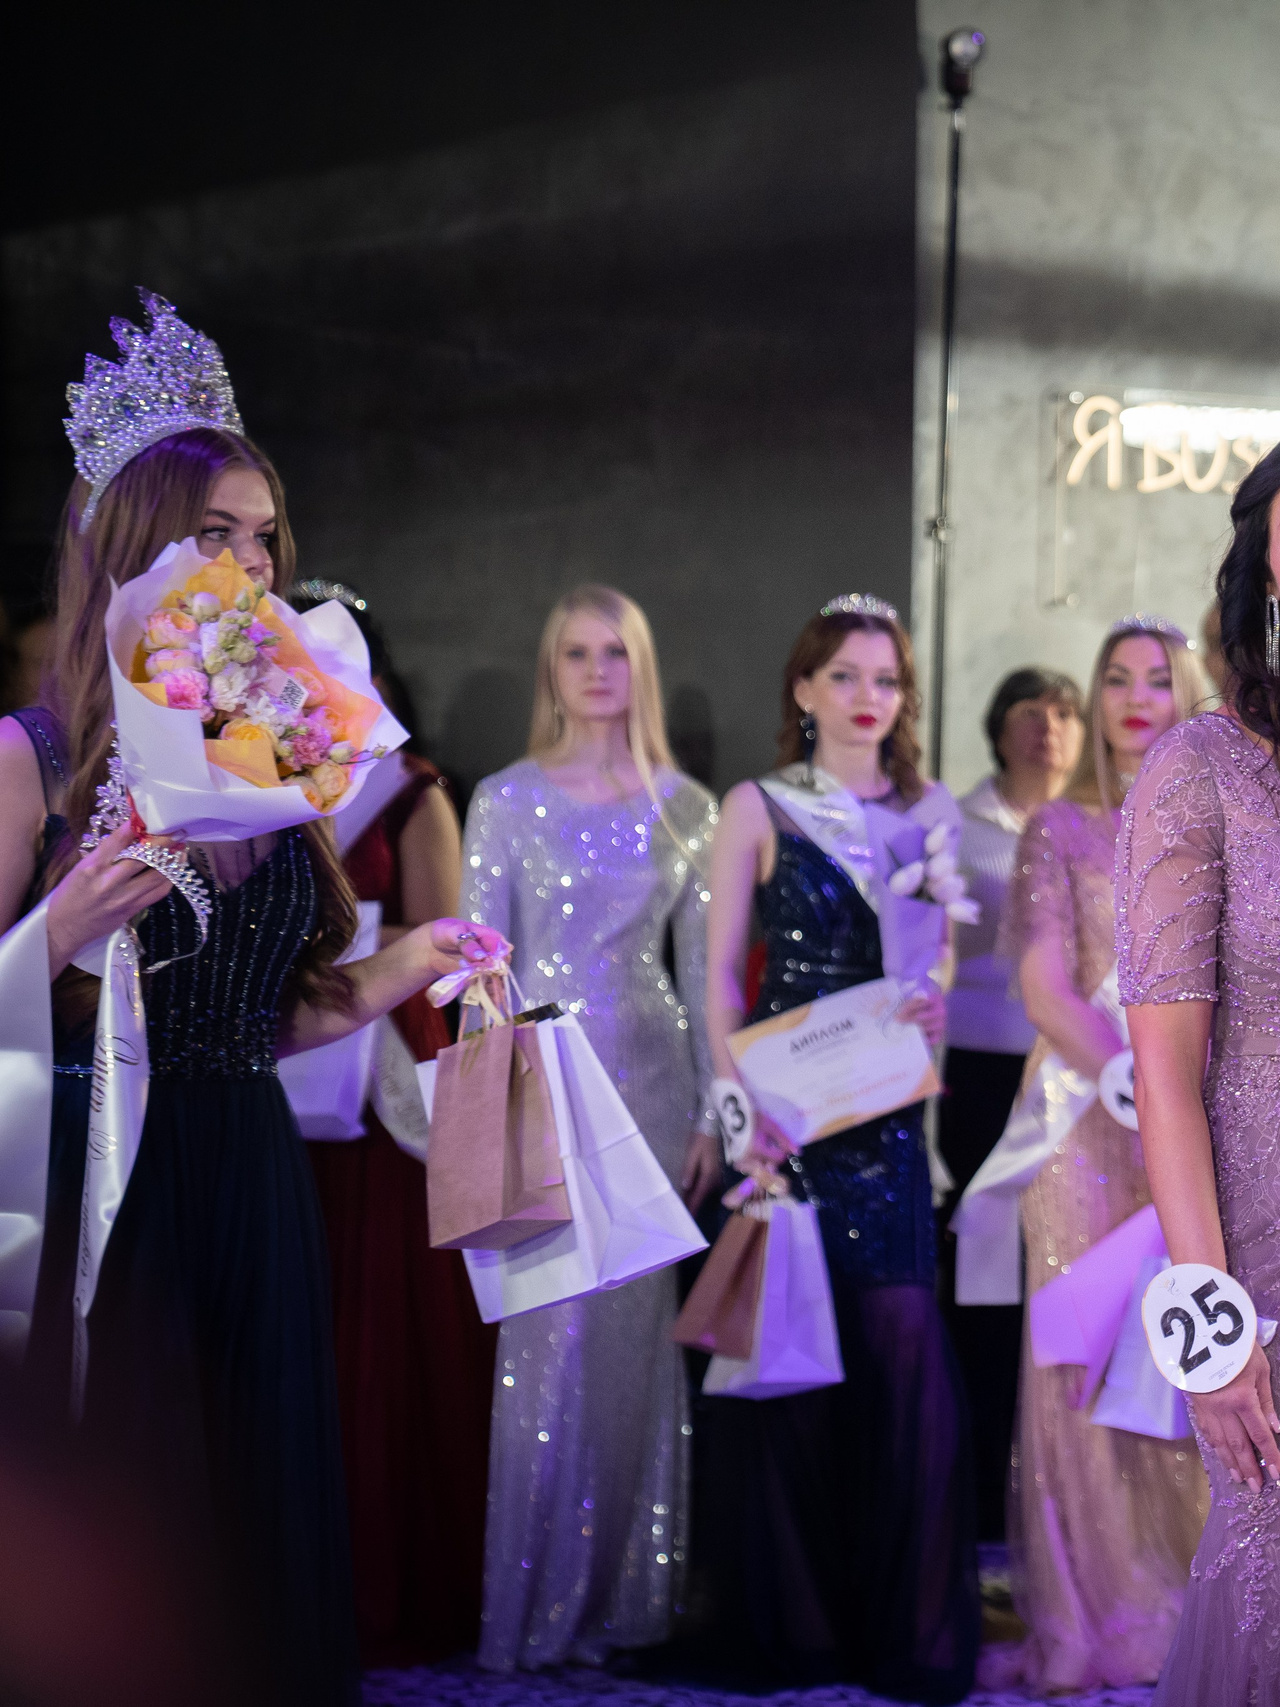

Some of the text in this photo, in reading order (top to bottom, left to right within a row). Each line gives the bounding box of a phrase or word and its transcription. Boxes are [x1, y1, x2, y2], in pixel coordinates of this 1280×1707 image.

[1066, 395, 1122, 491] Я
[789, 1018, 855, 1052] ДИПЛОМ
[1160, 1278, 1245, 1375] 25
